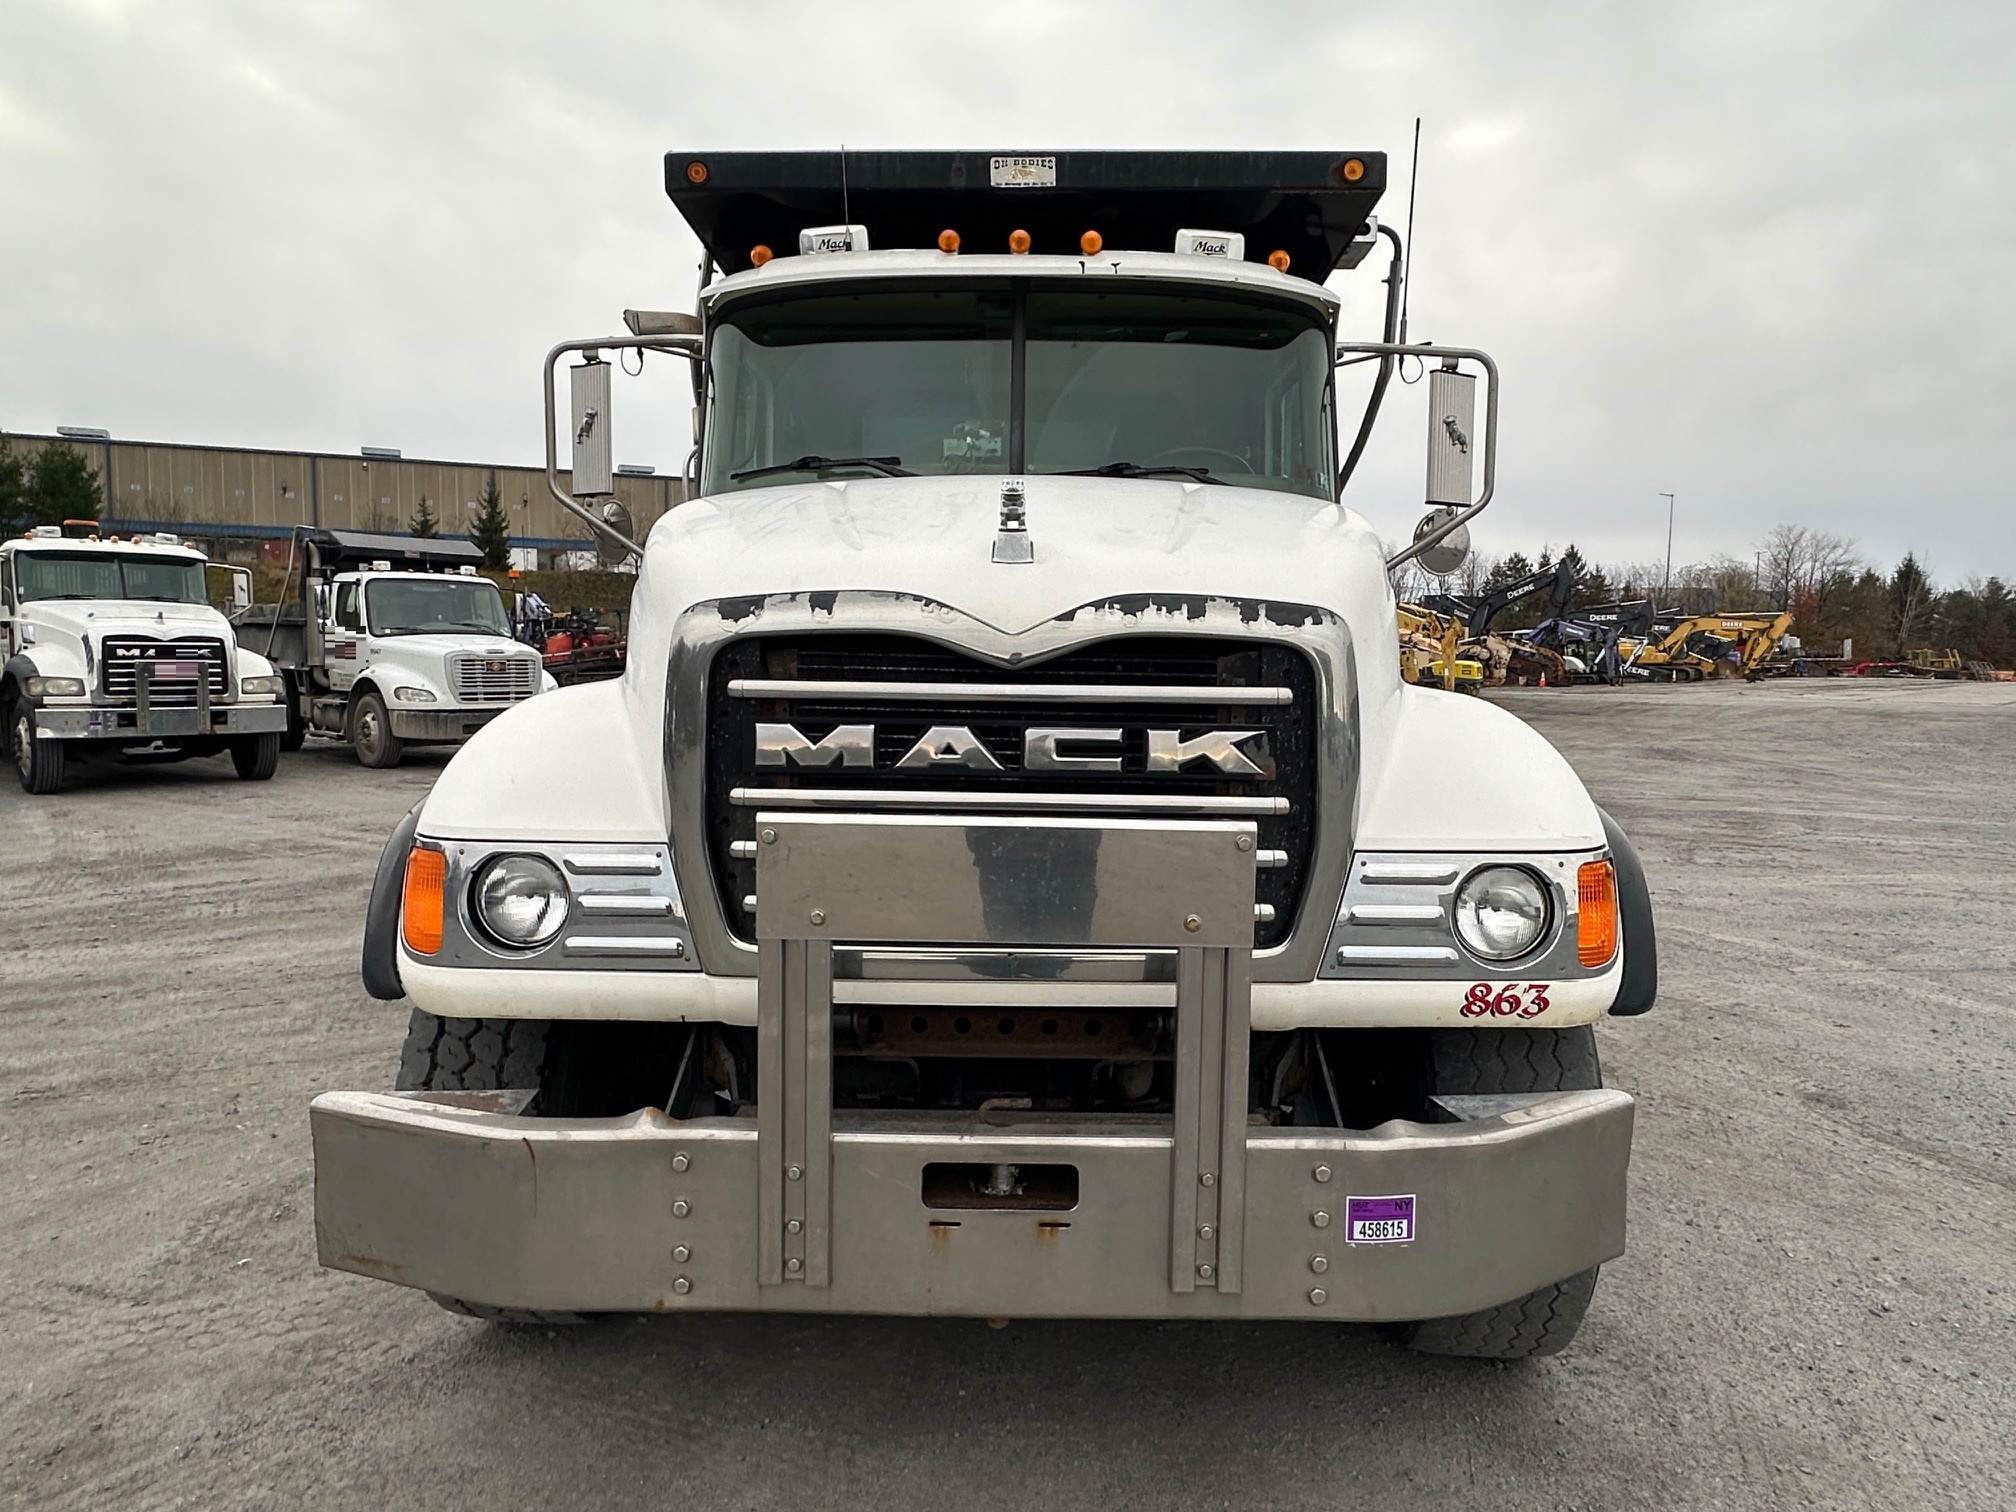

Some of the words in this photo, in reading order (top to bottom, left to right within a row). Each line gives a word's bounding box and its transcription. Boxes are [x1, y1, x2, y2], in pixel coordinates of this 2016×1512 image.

[1013, 159, 1054, 170] BODIES
[1193, 241, 1226, 253] Mack
[1506, 582, 1535, 600] DEERE
[755, 723, 1270, 776] MACK
[1459, 982, 1550, 1020] 863
[1352, 1201, 1370, 1209] HUT
[1394, 1200, 1412, 1211] NY
[1358, 1220, 1404, 1238] 458615
